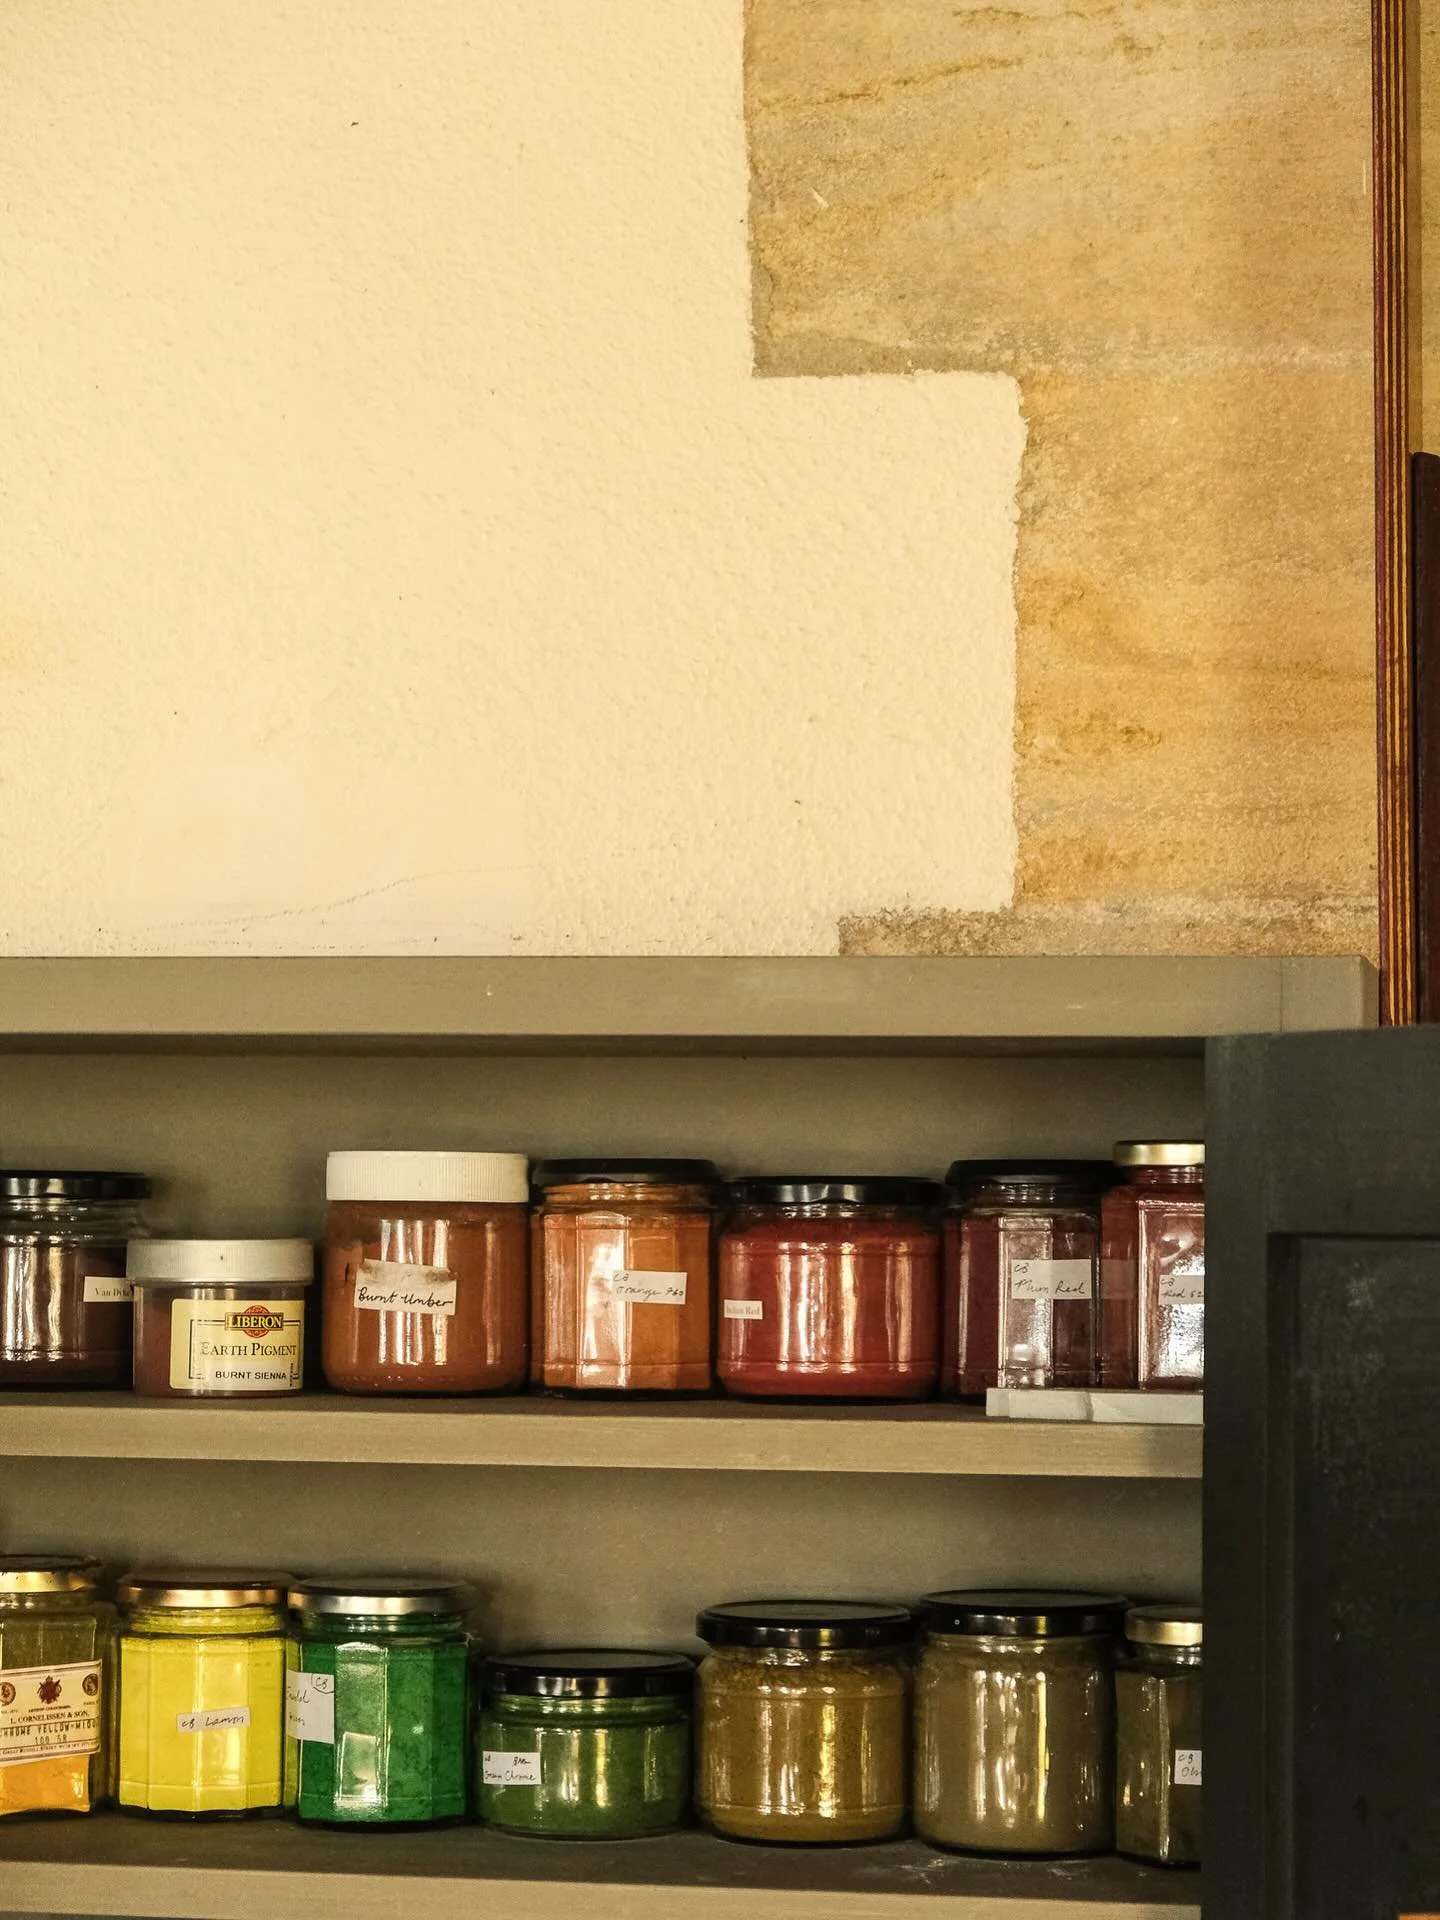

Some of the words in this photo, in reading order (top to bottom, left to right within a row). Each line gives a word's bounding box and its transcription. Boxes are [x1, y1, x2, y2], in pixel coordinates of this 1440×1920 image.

[95, 1287, 111, 1297] Van
[1054, 1280, 1086, 1294] Red
[358, 1286, 397, 1304] Burnt
[401, 1291, 454, 1308] Umber
[228, 1315, 283, 1331] LIBERON
[200, 1341, 248, 1356] EARTH
[251, 1342, 297, 1356] PIGMENT
[215, 1370, 252, 1380] BURNT
[254, 1371, 287, 1380] SIENNA
[18, 1711, 67, 1724] CORNELISSEN
[67, 1711, 73, 1719] &
[0, 1725, 31, 1738] HROME
